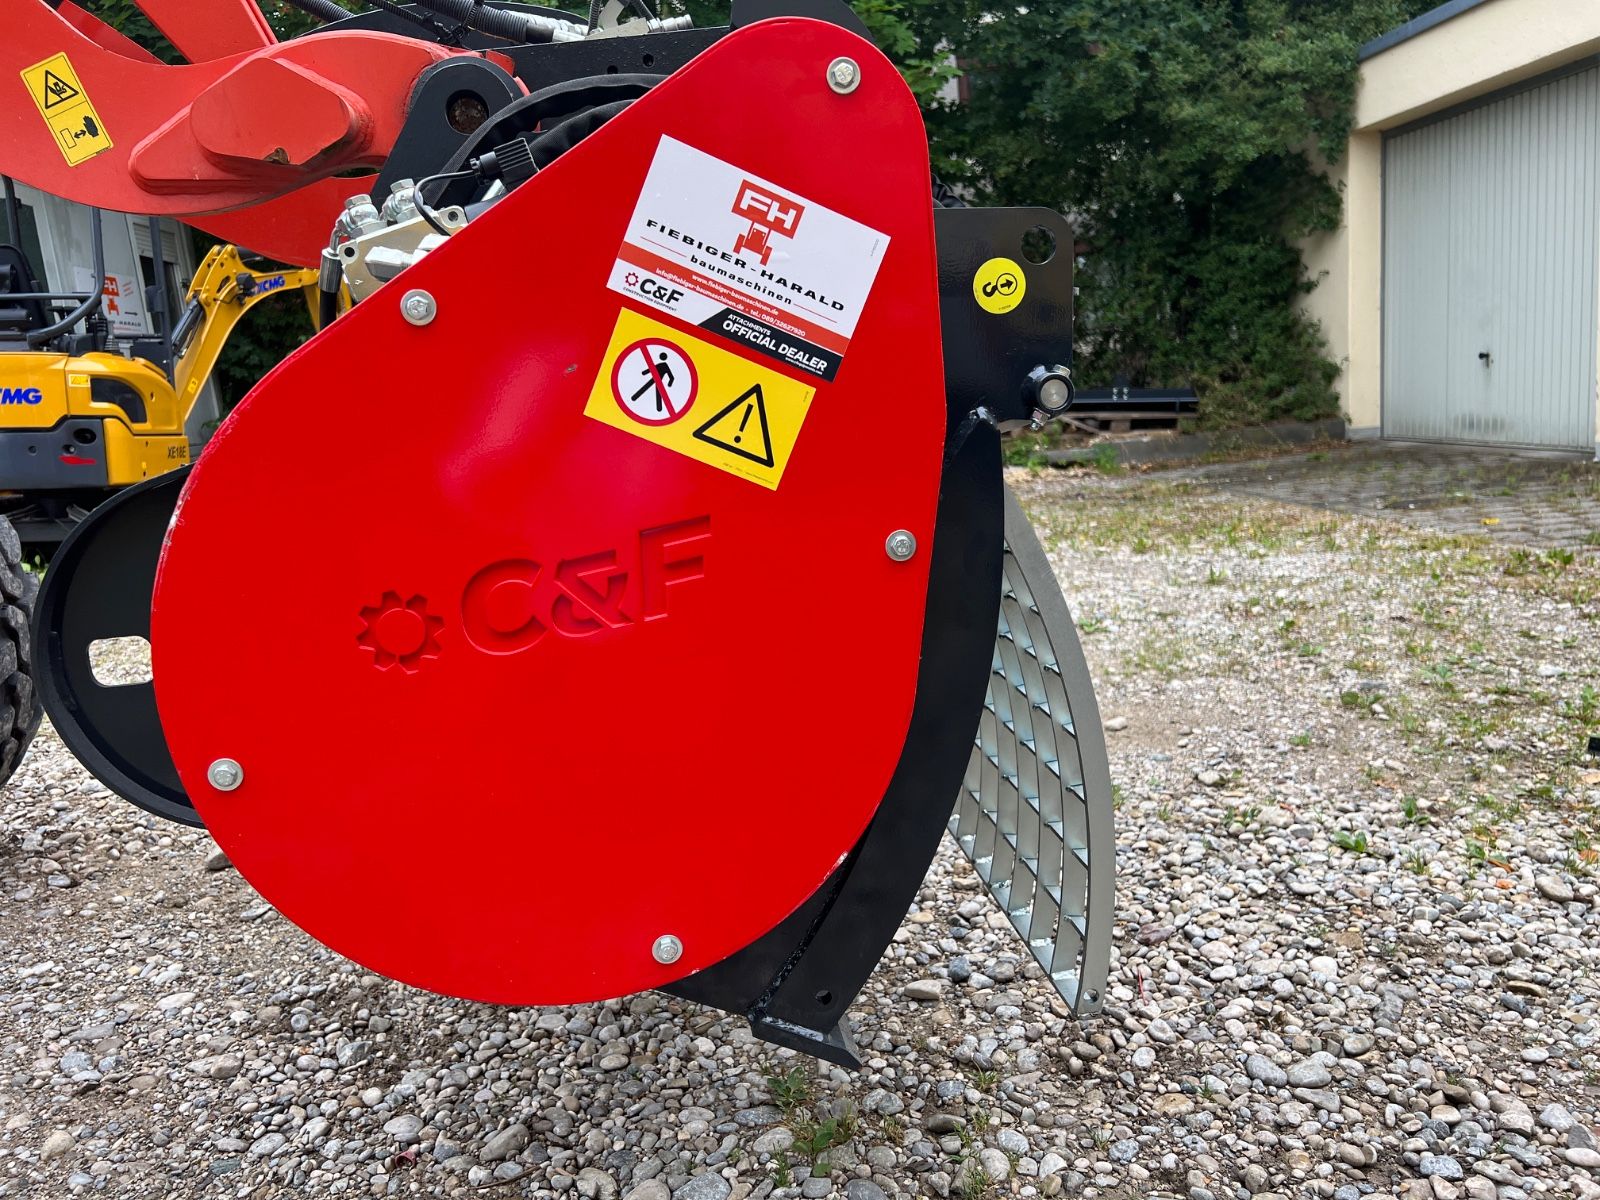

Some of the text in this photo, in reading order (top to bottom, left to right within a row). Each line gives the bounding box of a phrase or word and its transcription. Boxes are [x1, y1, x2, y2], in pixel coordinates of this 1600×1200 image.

[740, 188, 797, 229] FH
[639, 278, 684, 305] C&F
[690, 254, 792, 305] baumaschinen
[691, 274, 779, 316] www.fiebiger-baumaschinen.de
[623, 286, 677, 312] CONSTRUCTION EQUIPMENT
[727, 313, 772, 336] ATTACHMENTS
[761, 313, 806, 336] 089/32627920
[722, 320, 776, 350] OFFICIAL
[777, 343, 828, 371] DEALER
[167, 446, 187, 458] XE18E
[461, 514, 712, 656] C&F
